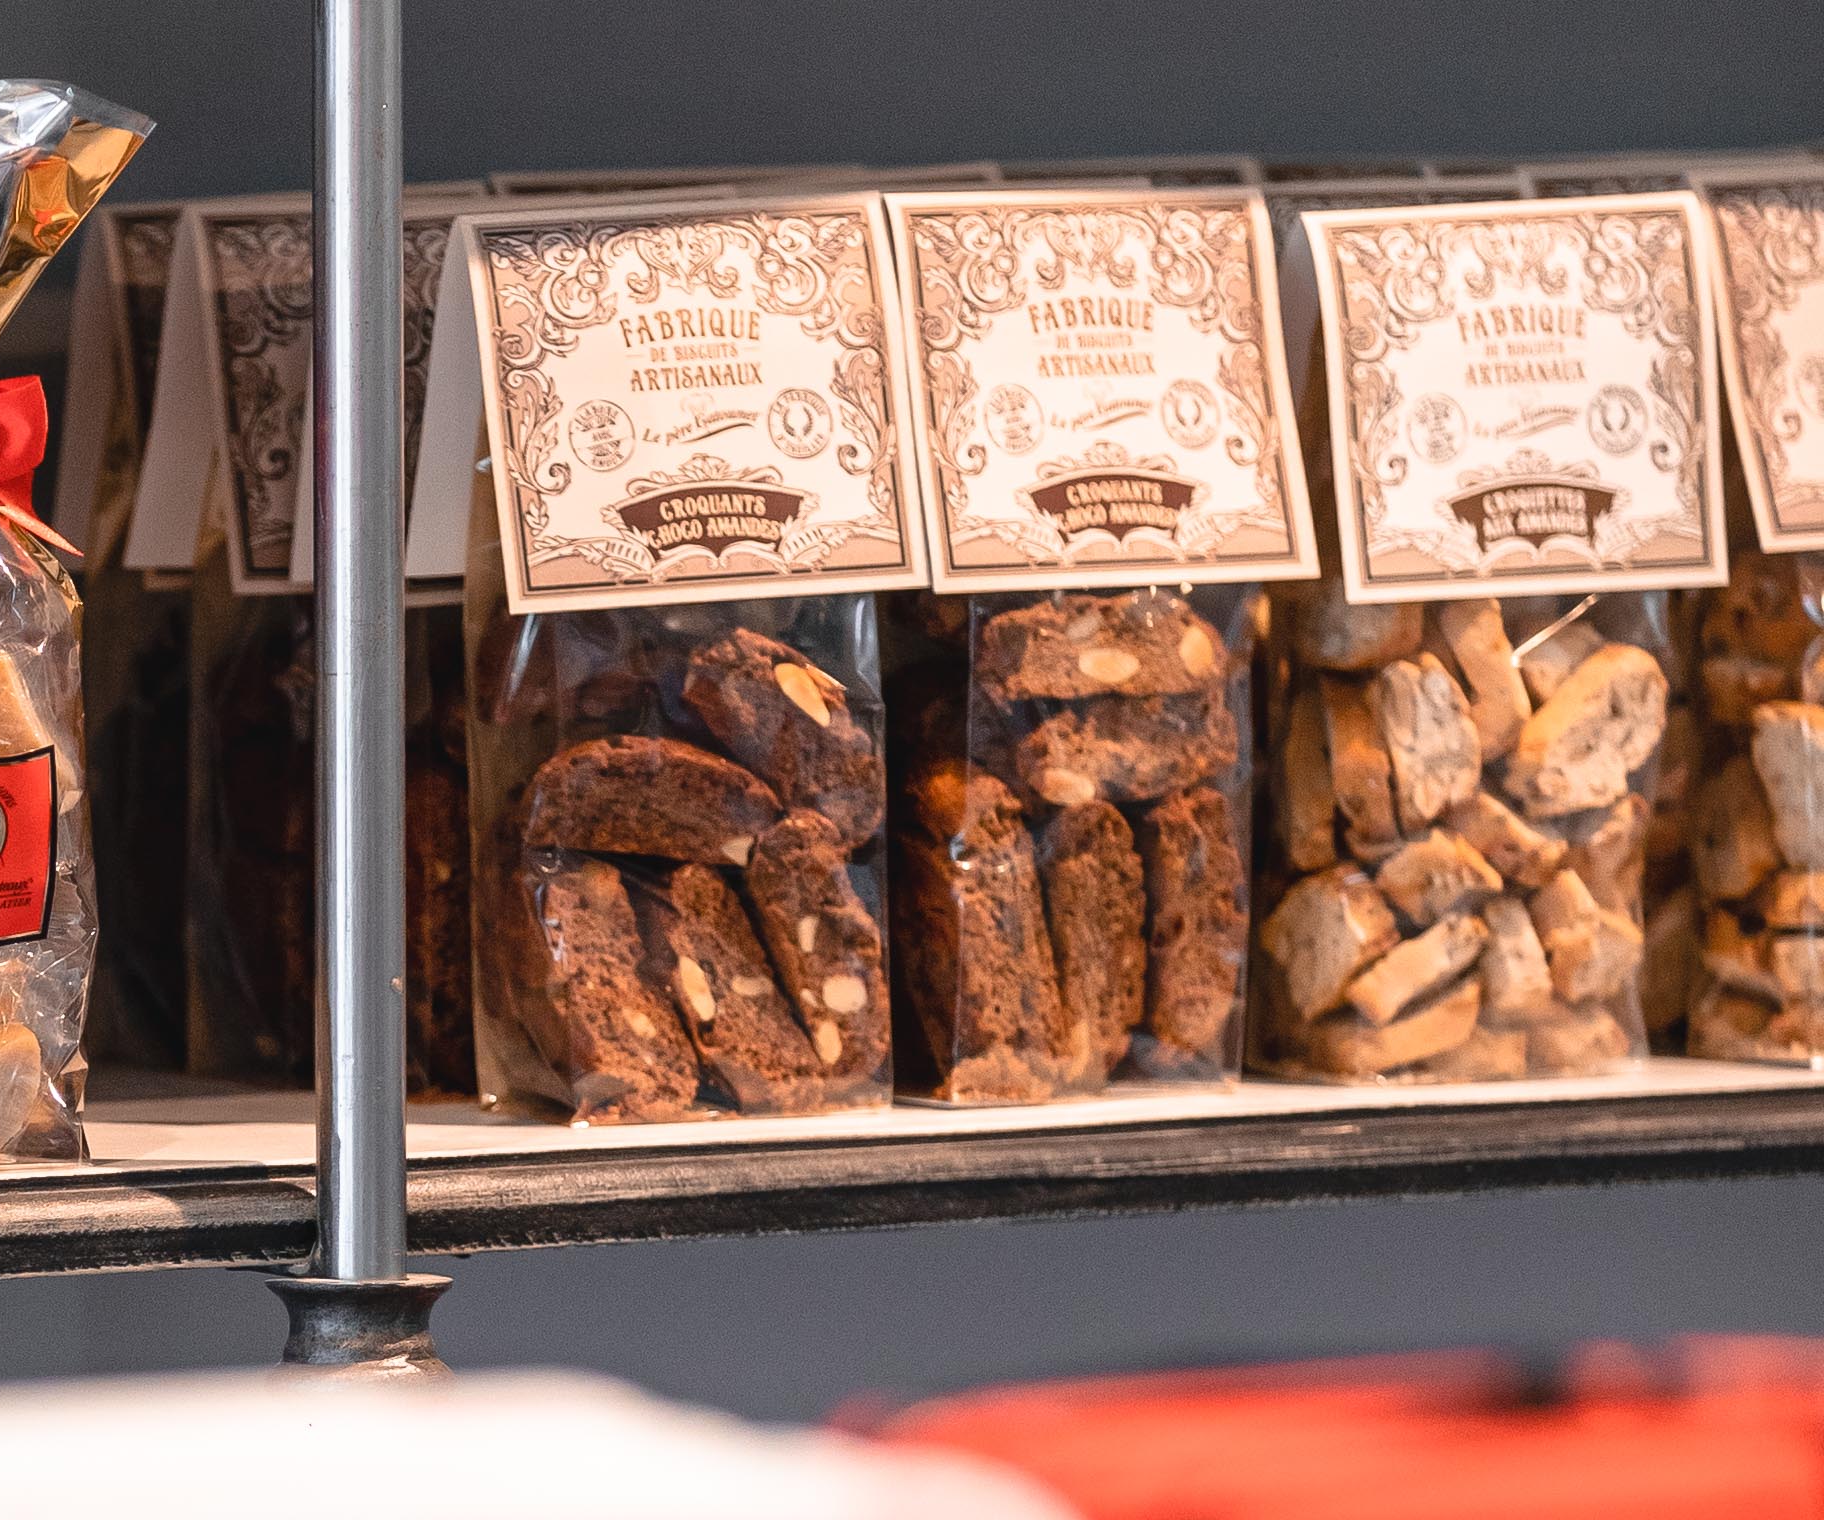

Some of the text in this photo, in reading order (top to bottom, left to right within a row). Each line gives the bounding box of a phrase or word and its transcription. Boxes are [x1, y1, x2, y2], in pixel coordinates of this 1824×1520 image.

[620, 308, 760, 348] FABRIQUE
[1027, 296, 1155, 334] FABRIQUE
[1457, 304, 1586, 343] FABRIQUE
[650, 343, 738, 362] DE BISCUITS
[1038, 352, 1157, 378] ARTISANAUX
[630, 362, 763, 392] ARTISANAUX
[659, 494, 767, 522] CROQUANTS
[648, 517, 781, 548] CHOCO AMANDES
